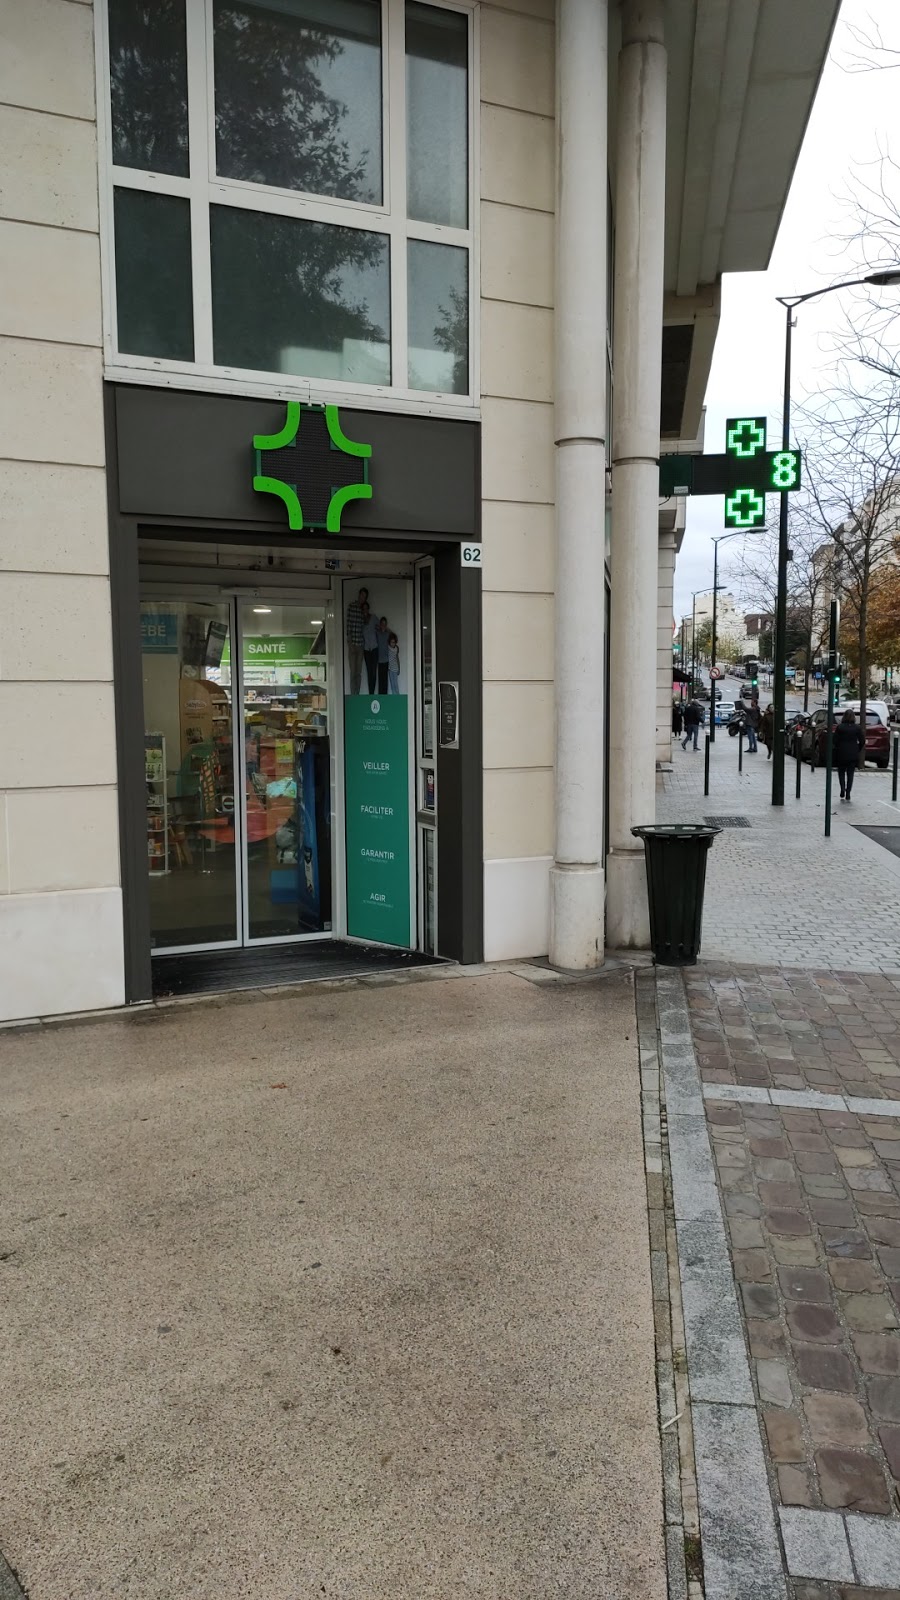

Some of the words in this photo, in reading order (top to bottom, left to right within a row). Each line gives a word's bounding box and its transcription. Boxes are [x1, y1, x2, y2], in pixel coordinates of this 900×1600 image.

[773, 452, 797, 486] 8
[463, 547, 481, 562] 62
[140, 621, 166, 637] ÉBÉ
[248, 641, 286, 654] SANTÉ
[362, 761, 390, 771] VEILLER
[360, 804, 394, 816] FACILITER
[360, 848, 395, 860] GARANTIR
[369, 892, 386, 903] AGIR
